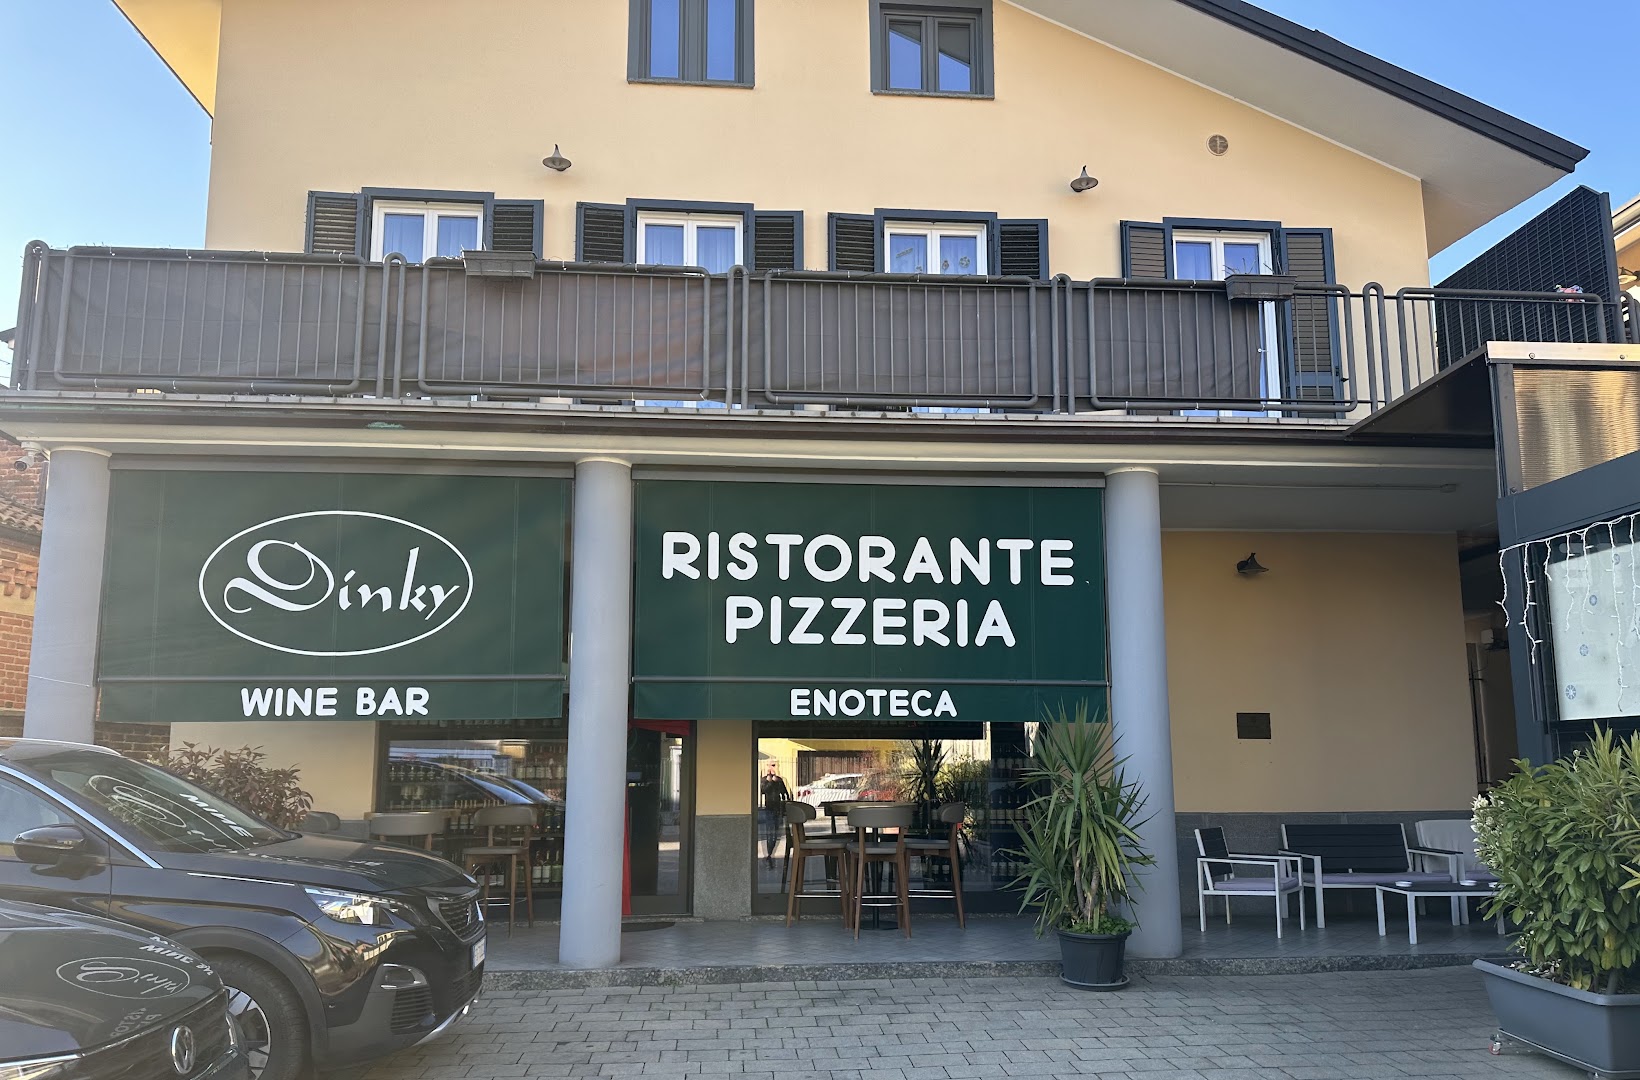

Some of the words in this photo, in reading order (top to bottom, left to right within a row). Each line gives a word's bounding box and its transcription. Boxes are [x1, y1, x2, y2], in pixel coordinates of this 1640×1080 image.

[223, 539, 461, 620] Dinky
[662, 530, 1075, 586] RISTORANTE
[725, 595, 1016, 649] PIZZERIA
[240, 687, 339, 717] WINE
[355, 687, 431, 716] BAR
[790, 688, 958, 718] ENOTECA
